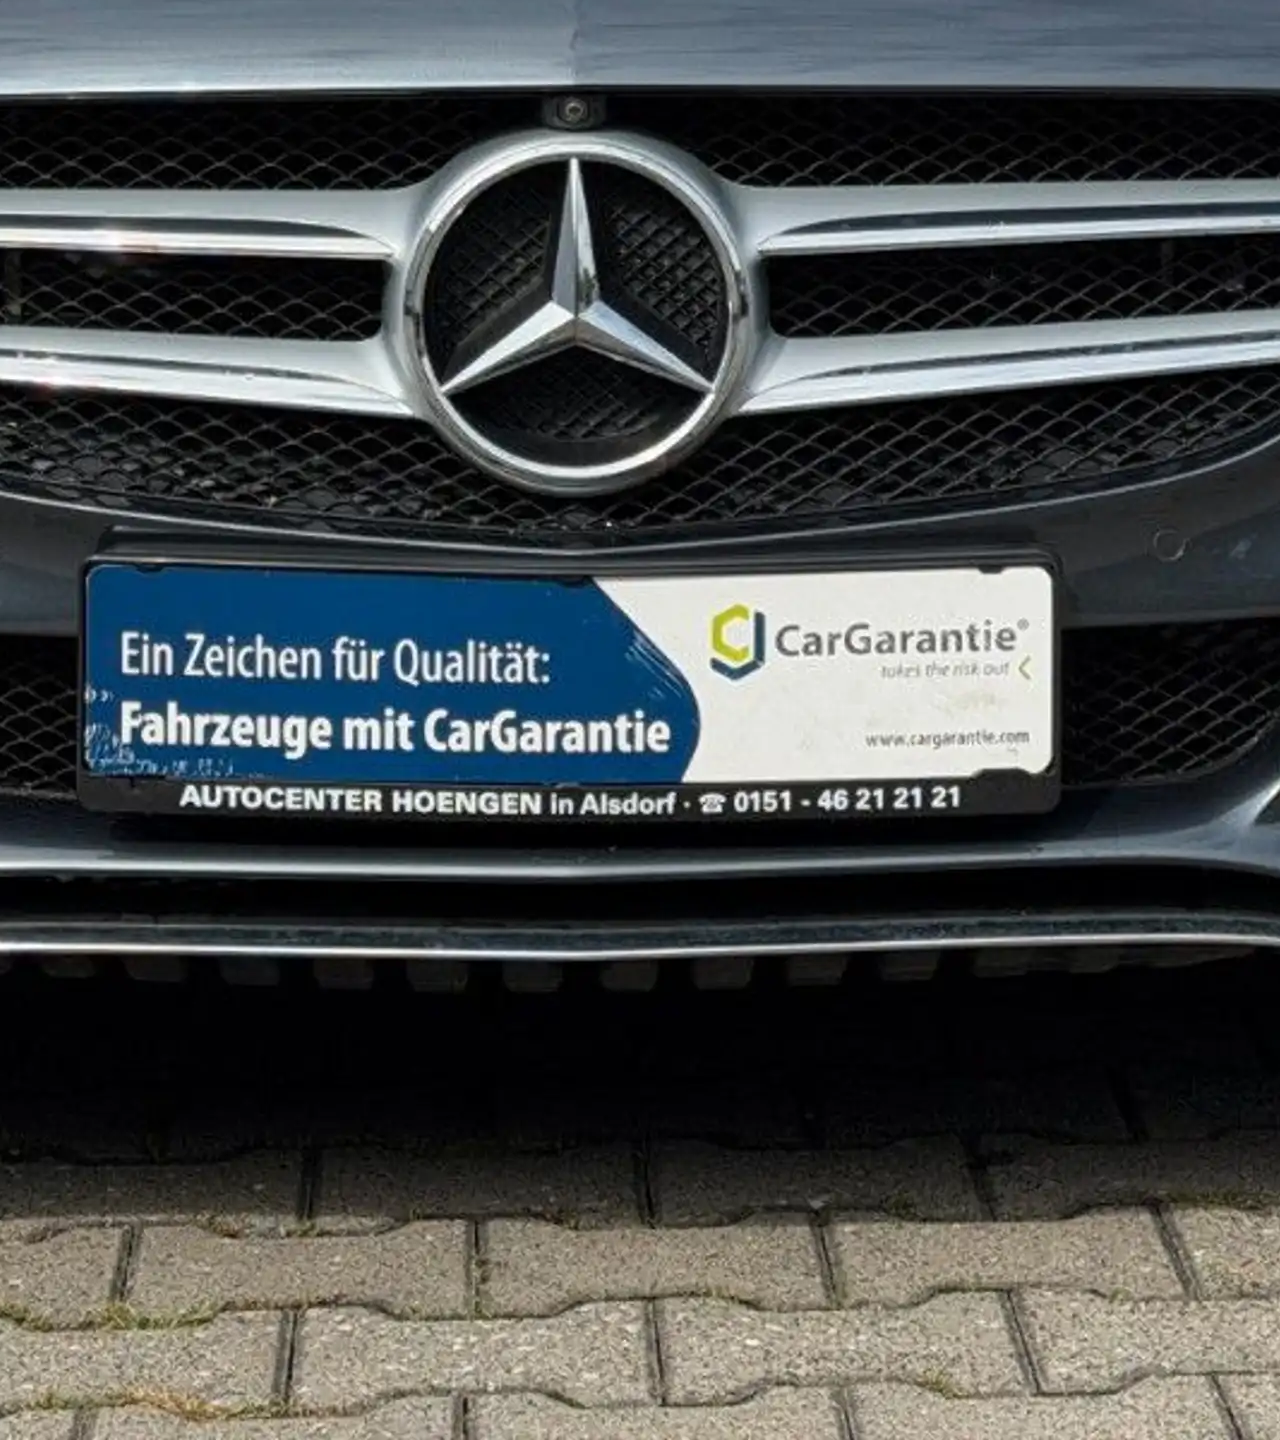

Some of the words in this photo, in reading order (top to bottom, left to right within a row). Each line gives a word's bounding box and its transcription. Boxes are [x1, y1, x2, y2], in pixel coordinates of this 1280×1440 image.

[120, 630, 174, 676] Ein
[183, 632, 322, 680] Zeichen
[332, 635, 386, 682] für
[393, 638, 551, 686] Qualität:
[120, 700, 334, 761] Fahrzeuge
[342, 706, 415, 752] mit
[423, 709, 672, 755] CarGarantie
[866, 729, 1030, 749] www.cargarantie.com
[179, 784, 383, 813] AUTOCENTER
[392, 789, 542, 815] HOENGEN
[550, 793, 575, 816] in
[580, 791, 677, 816] Alsdorf
[733, 790, 793, 814] 0151
[817, 788, 849, 812] 46
[854, 787, 885, 811] 21
[893, 786, 923, 810] 21
[931, 785, 961, 809] 21
